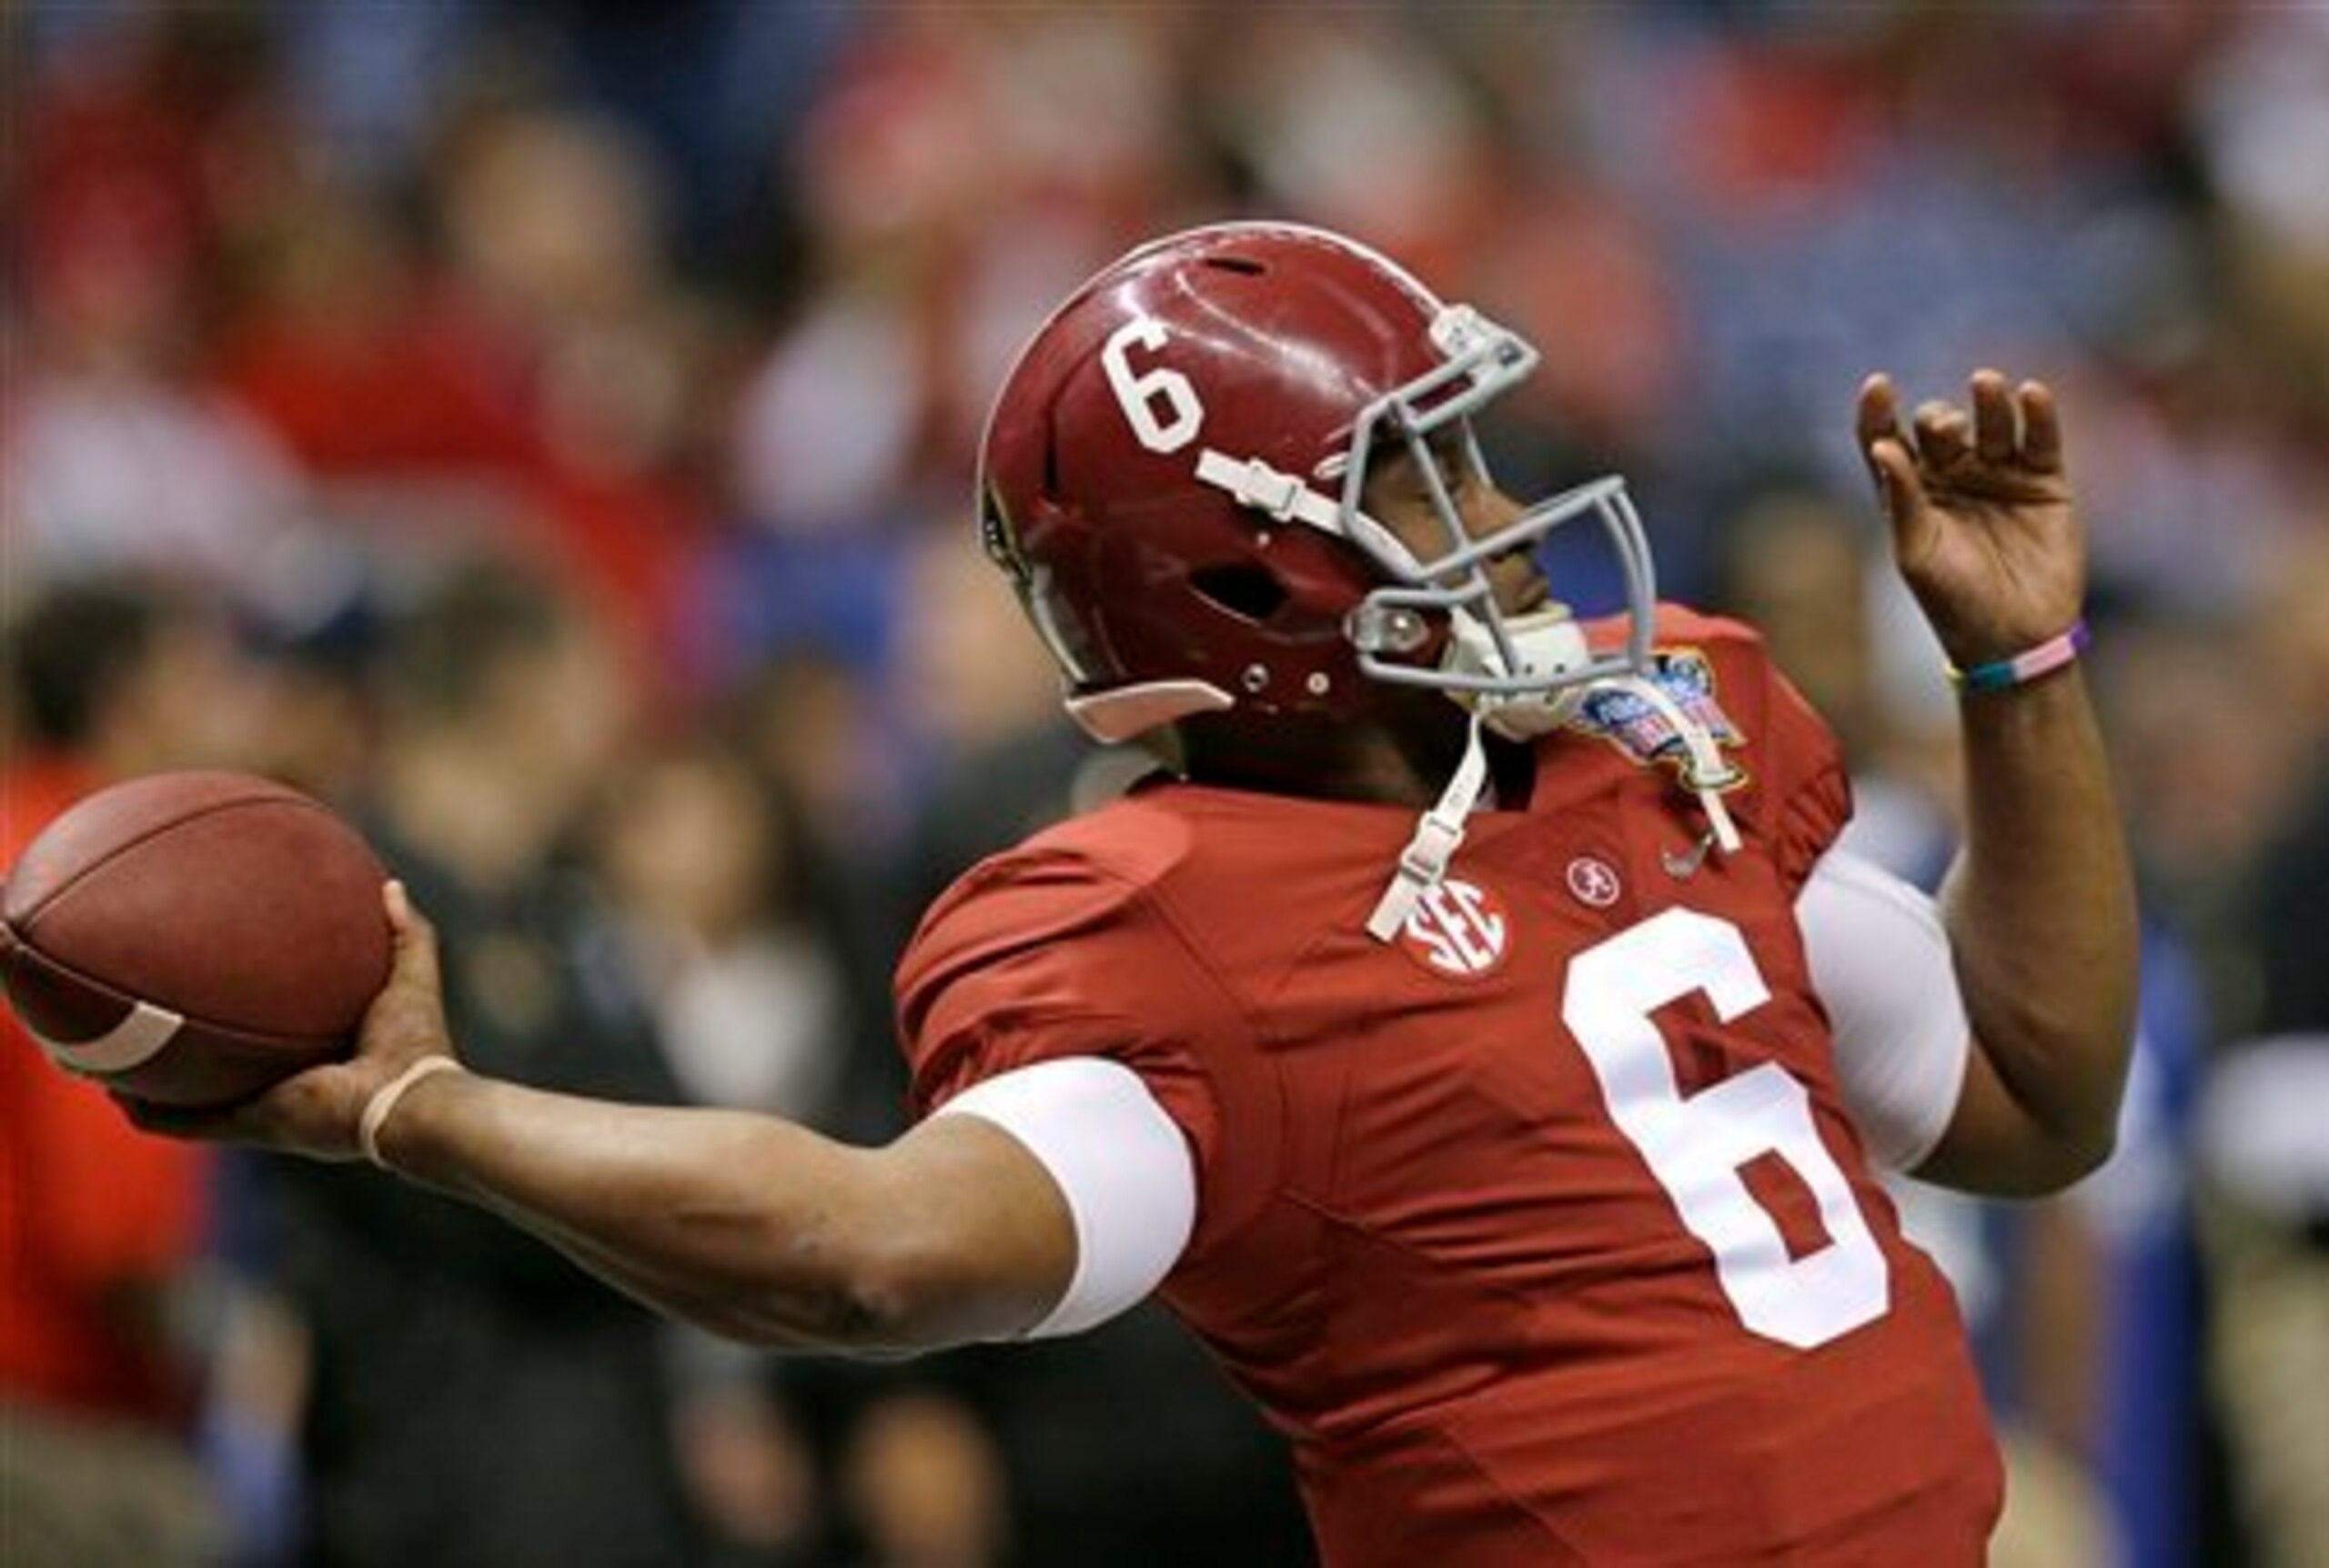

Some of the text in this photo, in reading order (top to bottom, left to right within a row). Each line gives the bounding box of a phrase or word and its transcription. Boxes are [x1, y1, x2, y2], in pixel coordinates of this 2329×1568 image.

[1102, 317, 1205, 453] 6
[1406, 879, 1505, 973] SEC
[1562, 906, 1890, 1350] 6
